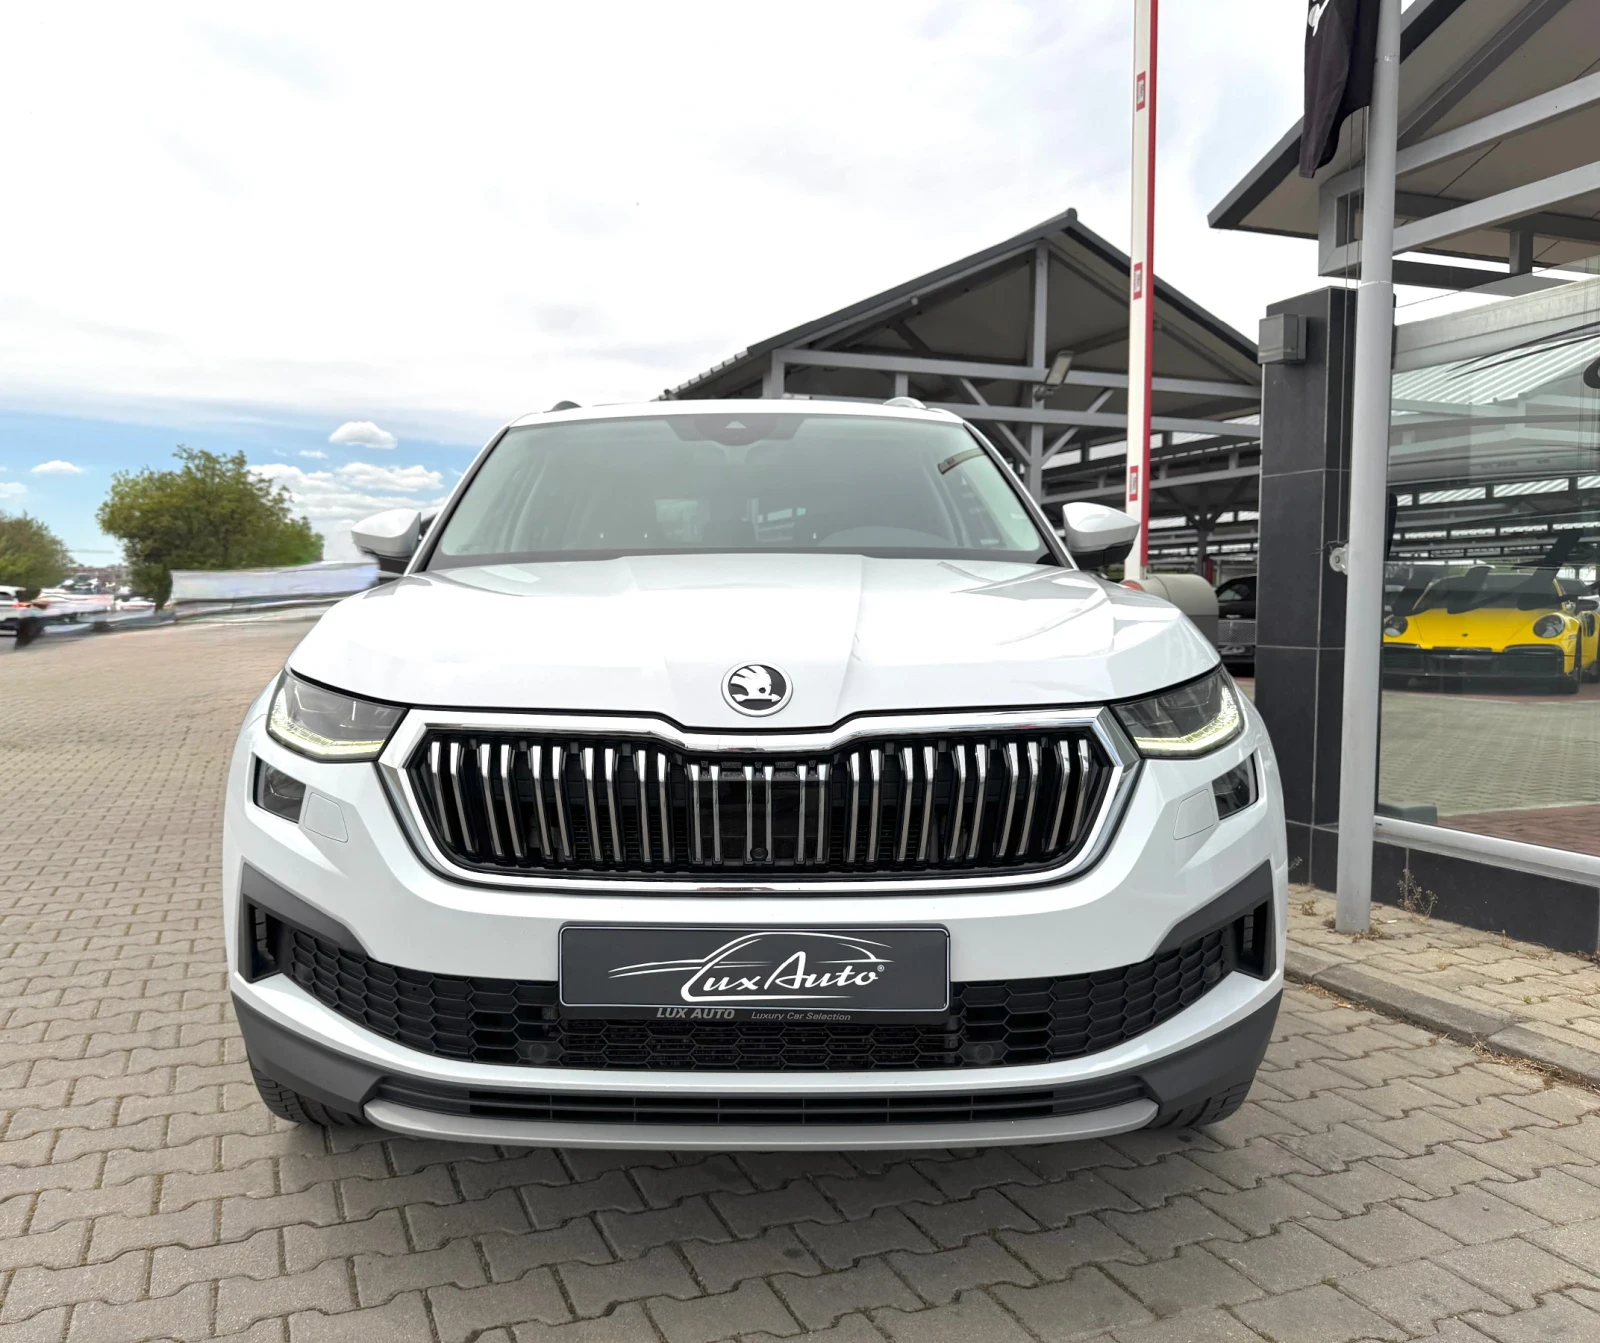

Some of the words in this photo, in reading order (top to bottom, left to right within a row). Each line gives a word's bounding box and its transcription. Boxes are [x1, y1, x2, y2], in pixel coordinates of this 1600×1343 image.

[656, 1007, 689, 1019] LUX
[690, 1008, 736, 1020] AUTO
[751, 1011, 785, 1021] Luxury
[786, 1011, 804, 1021] Car
[805, 1012, 851, 1021] Selection
